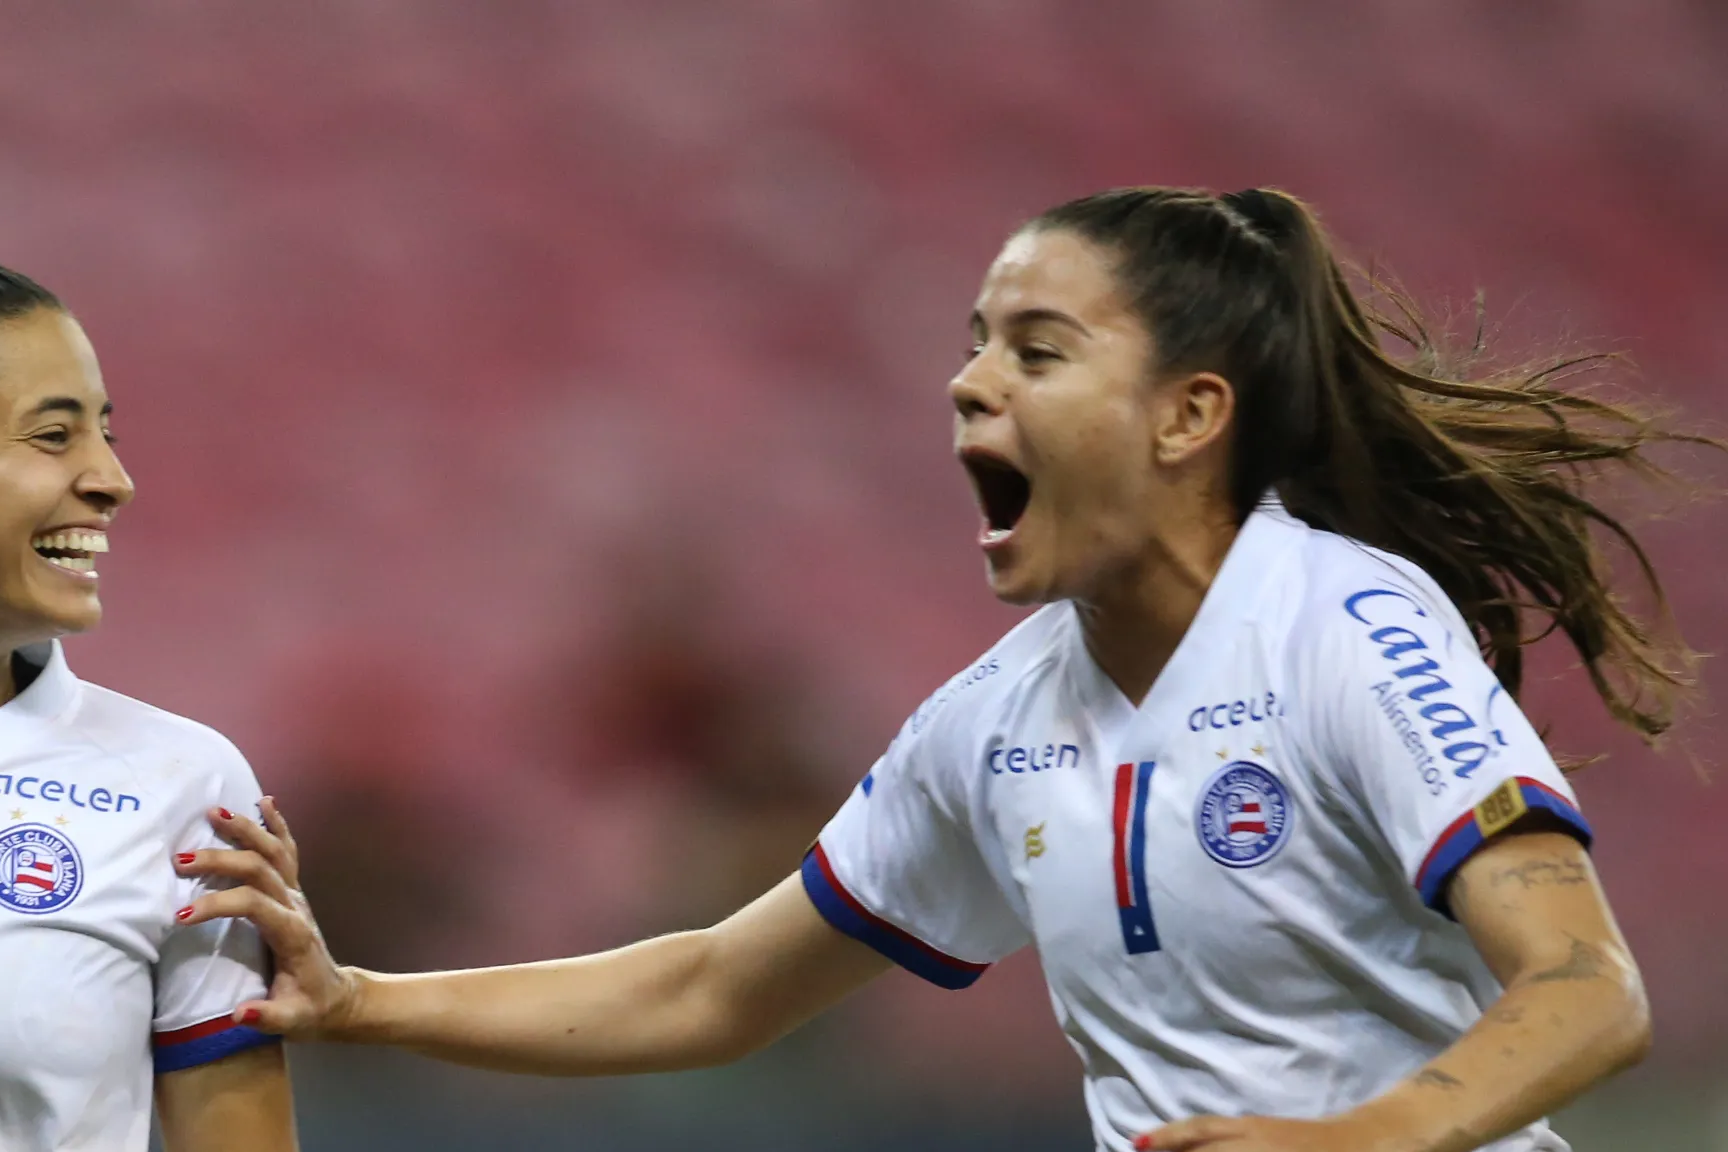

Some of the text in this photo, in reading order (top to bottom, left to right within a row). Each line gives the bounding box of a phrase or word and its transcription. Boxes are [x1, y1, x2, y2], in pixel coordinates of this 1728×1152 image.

[1343, 588, 1509, 779] Canaã
[1369, 680, 1449, 797] Alimentos
[14, 895, 40, 906] 1931
[24, 831, 70, 861] CLUBE
[54, 861, 75, 897] BAHIA
